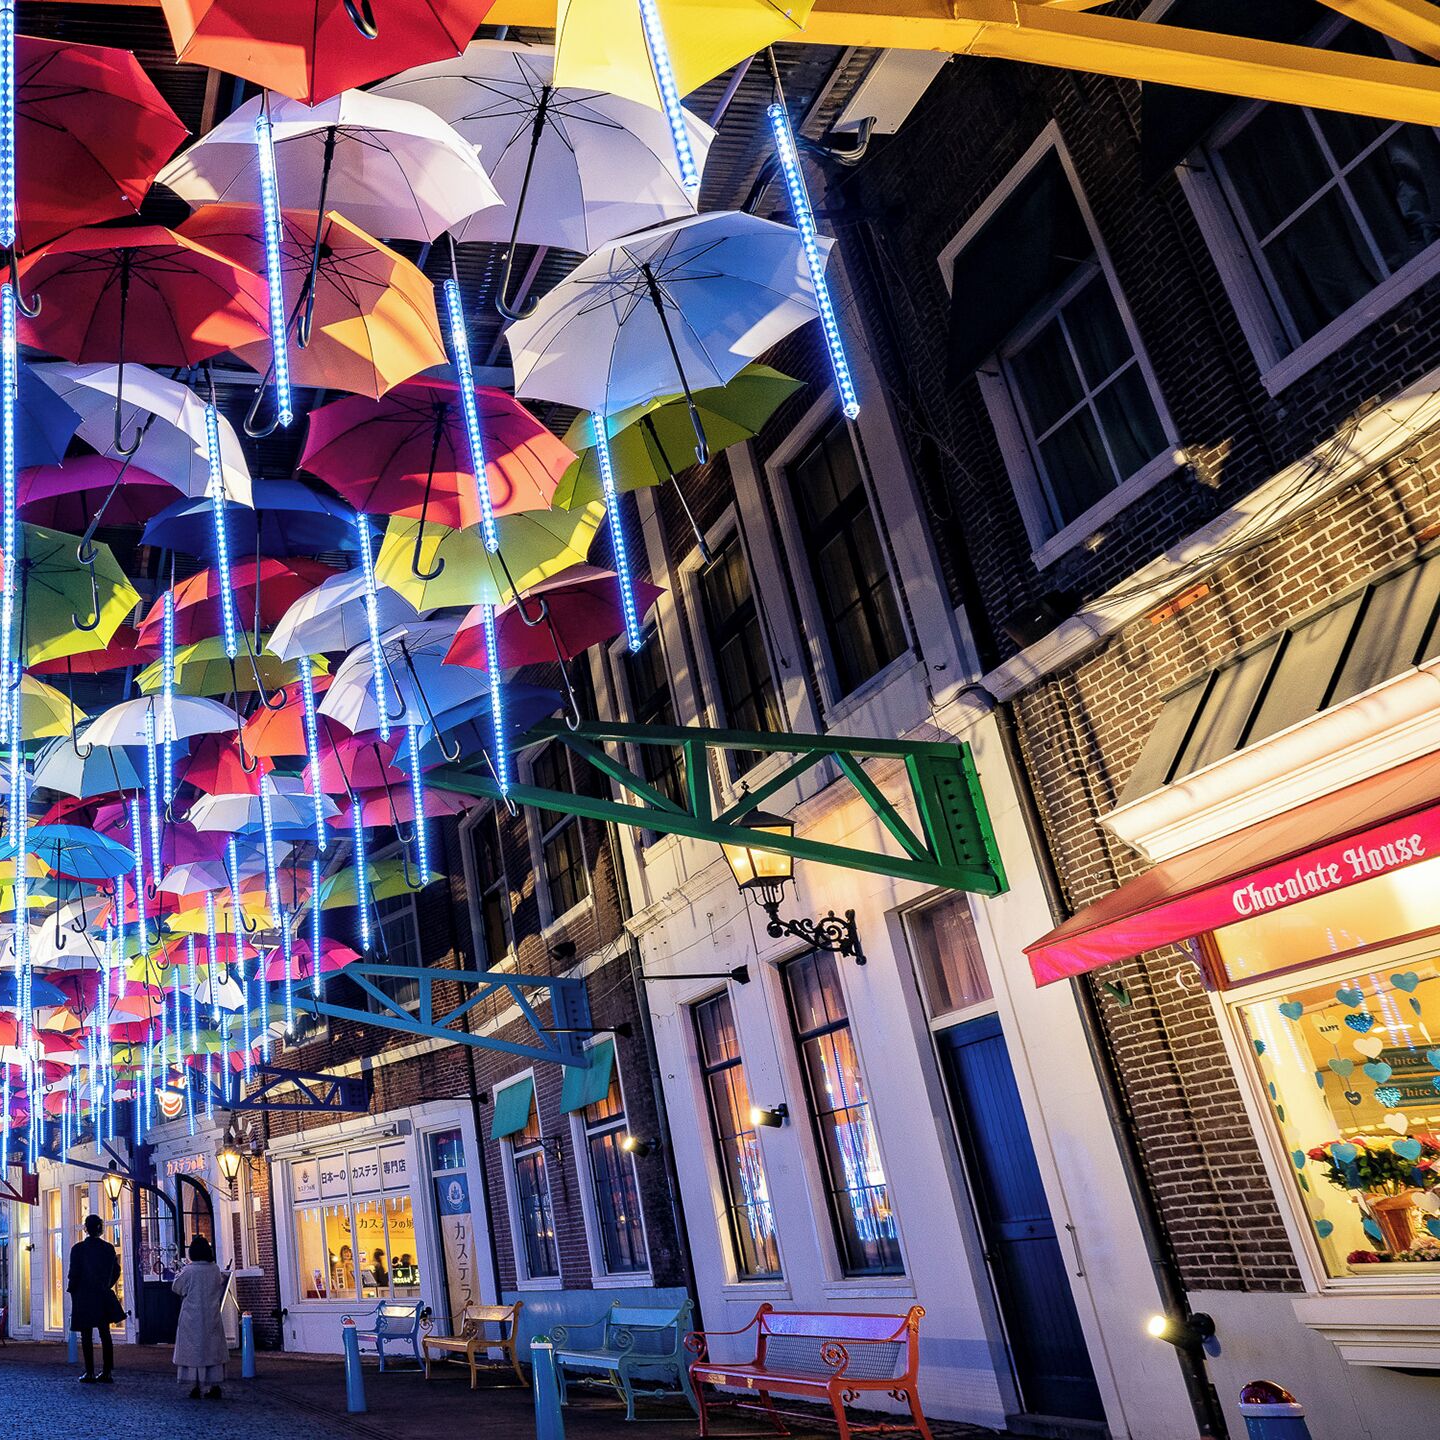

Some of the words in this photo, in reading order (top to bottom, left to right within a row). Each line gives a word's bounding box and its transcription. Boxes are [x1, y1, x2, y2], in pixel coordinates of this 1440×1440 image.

[1232, 862, 1343, 916] Chocolate
[1343, 833, 1426, 879] House
[1319, 1023, 1340, 1033] HAPPY
[1398, 1087, 1431, 1098] hite
[321, 1169, 347, 1184] 日本一の
[352, 1163, 378, 1180] カステラ
[383, 1159, 406, 1175] 専門店
[454, 1221, 472, 1302] カステラ
